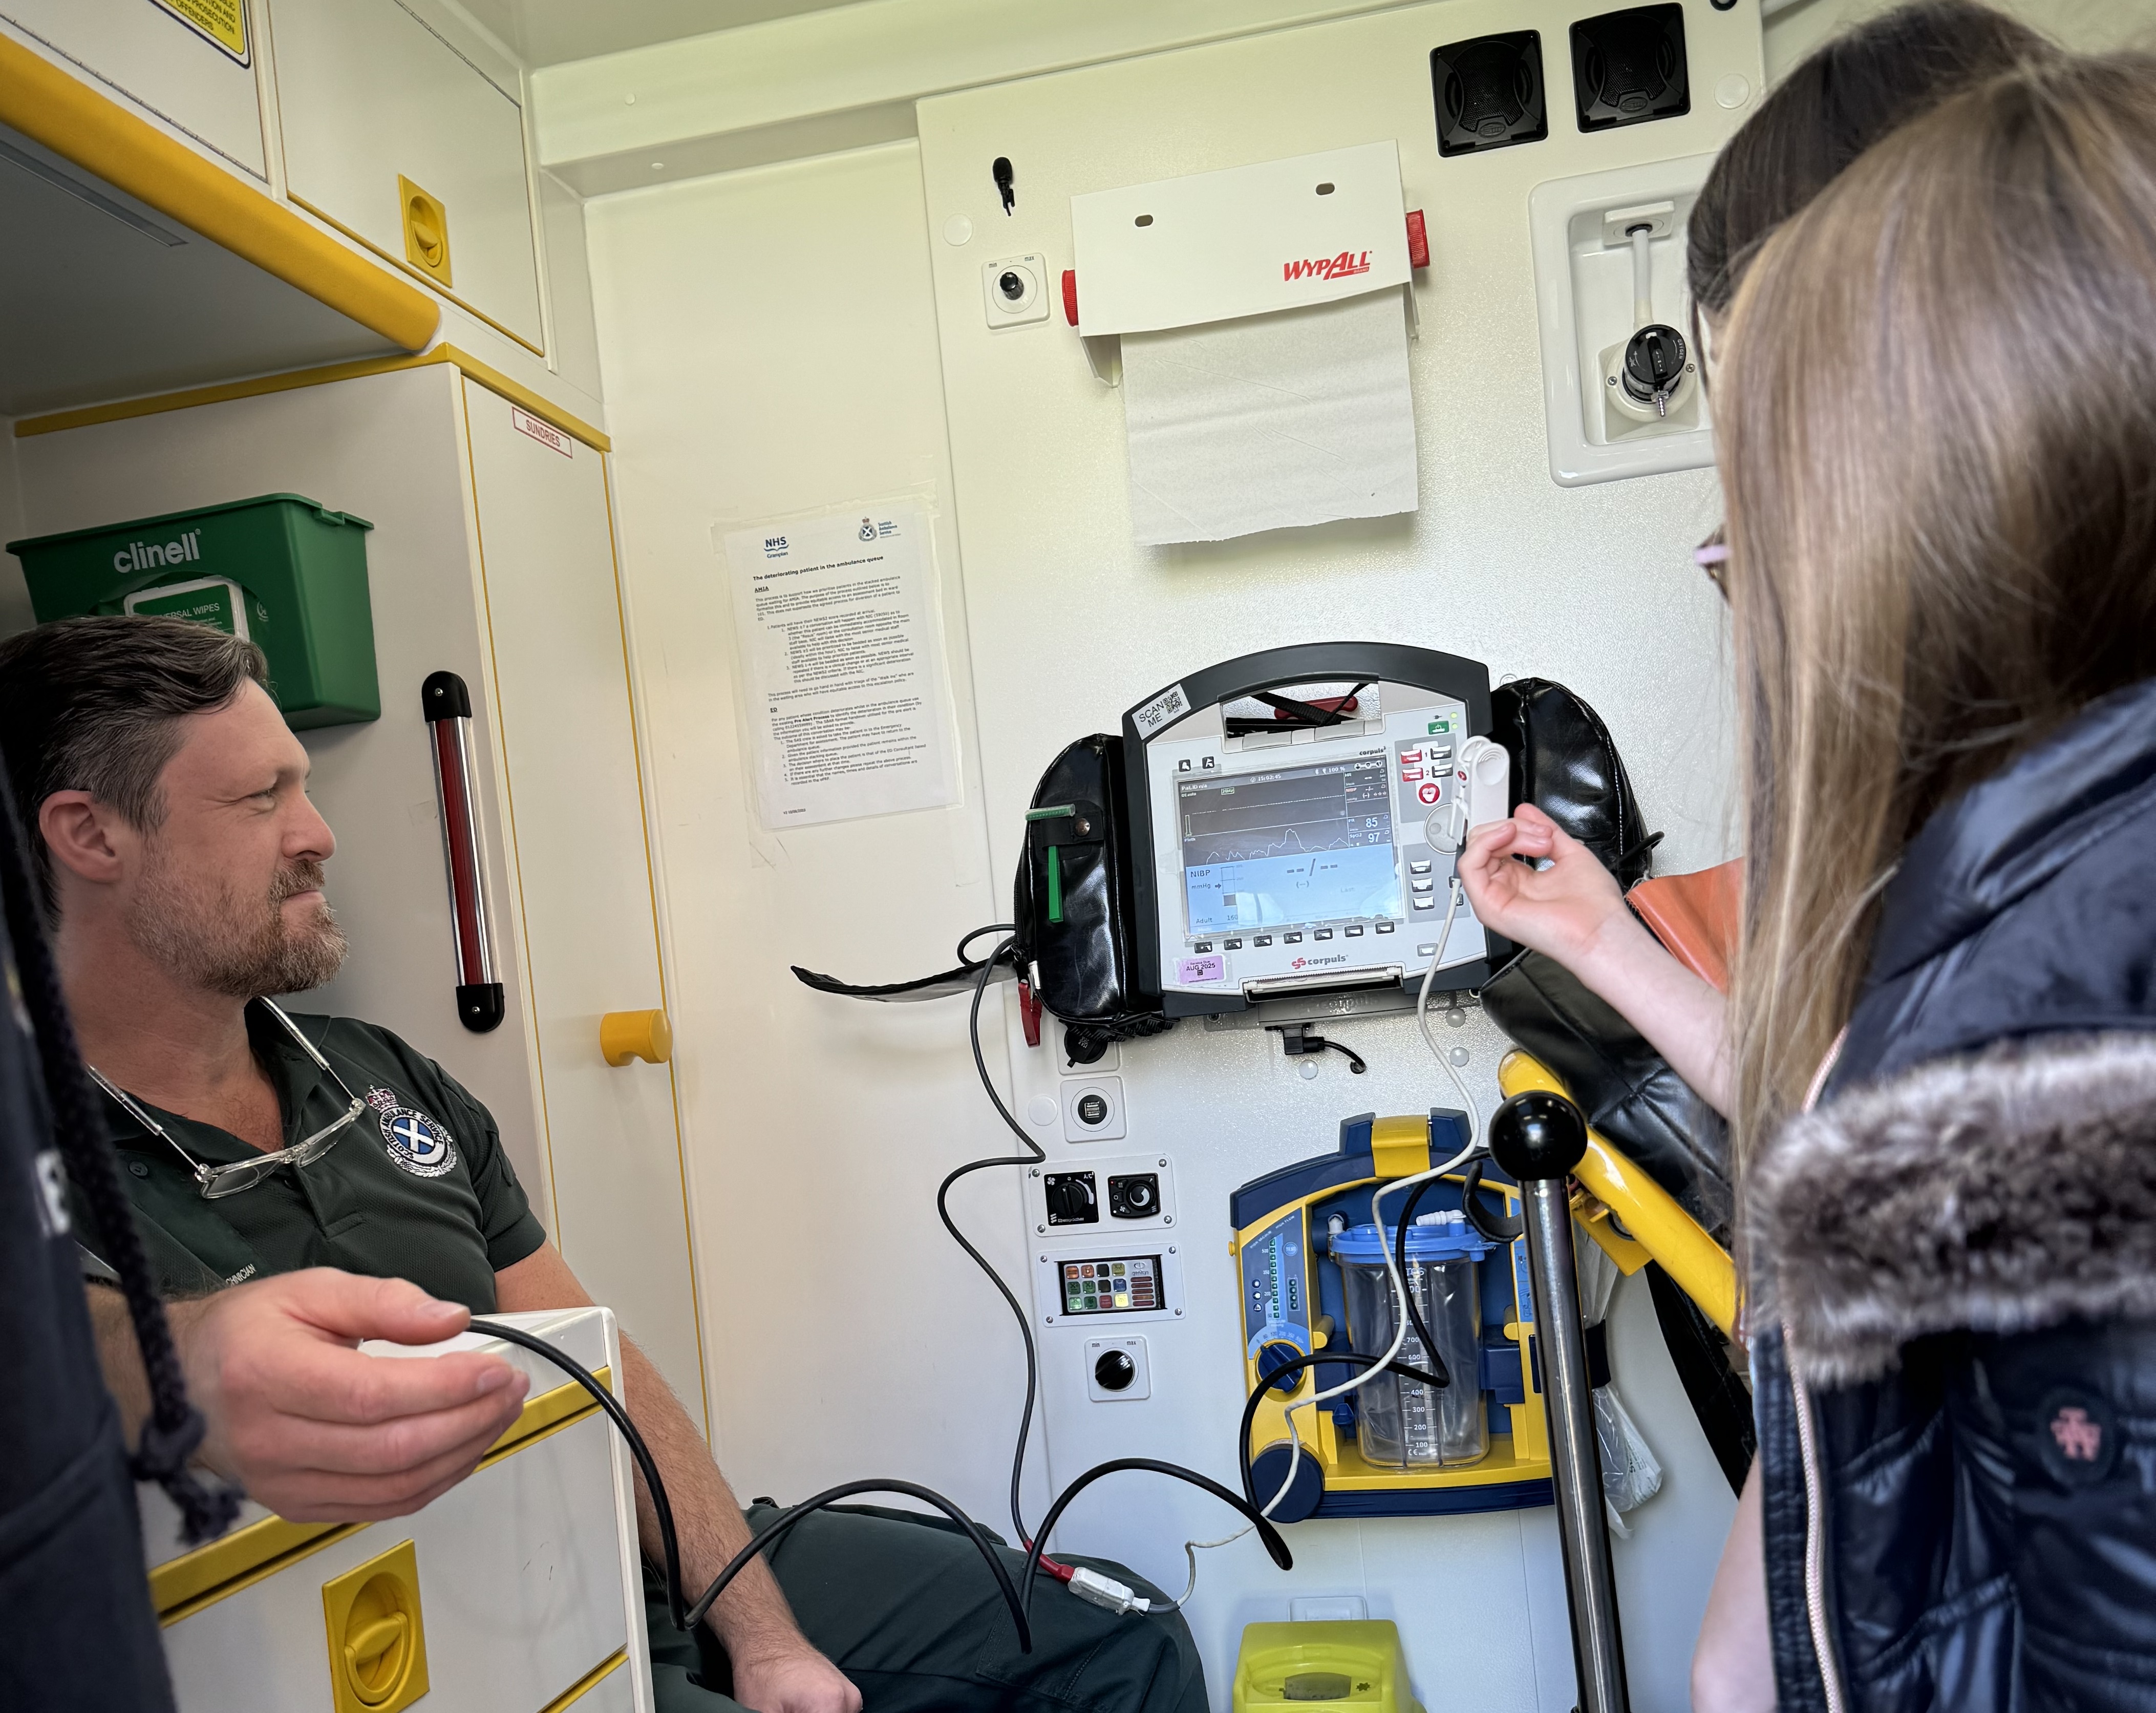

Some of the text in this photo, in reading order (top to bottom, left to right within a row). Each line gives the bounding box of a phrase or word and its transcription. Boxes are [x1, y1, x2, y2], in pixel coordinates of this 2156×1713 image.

[526, 419, 560, 447] SUNDRIES
[765, 536, 787, 548] NHS
[767, 551, 788, 559] Grampian
[763, 568, 799, 580] deteriorating
[799, 565, 819, 575] patient
[836, 557, 865, 567] ambulance
[866, 556, 883, 564] queue
[193, 603, 220, 615] WIPES
[1139, 701, 1164, 722] SCAN
[1147, 712, 1163, 727] ME
[1365, 817, 1378, 828] 85
[1368, 832, 1380, 843] 97
[1190, 869, 1210, 878] NIBP
[1307, 955, 1346, 967] corpuls
[381, 1108, 417, 1128] AMBULANCE
[419, 1115, 444, 1145] SERVICE
